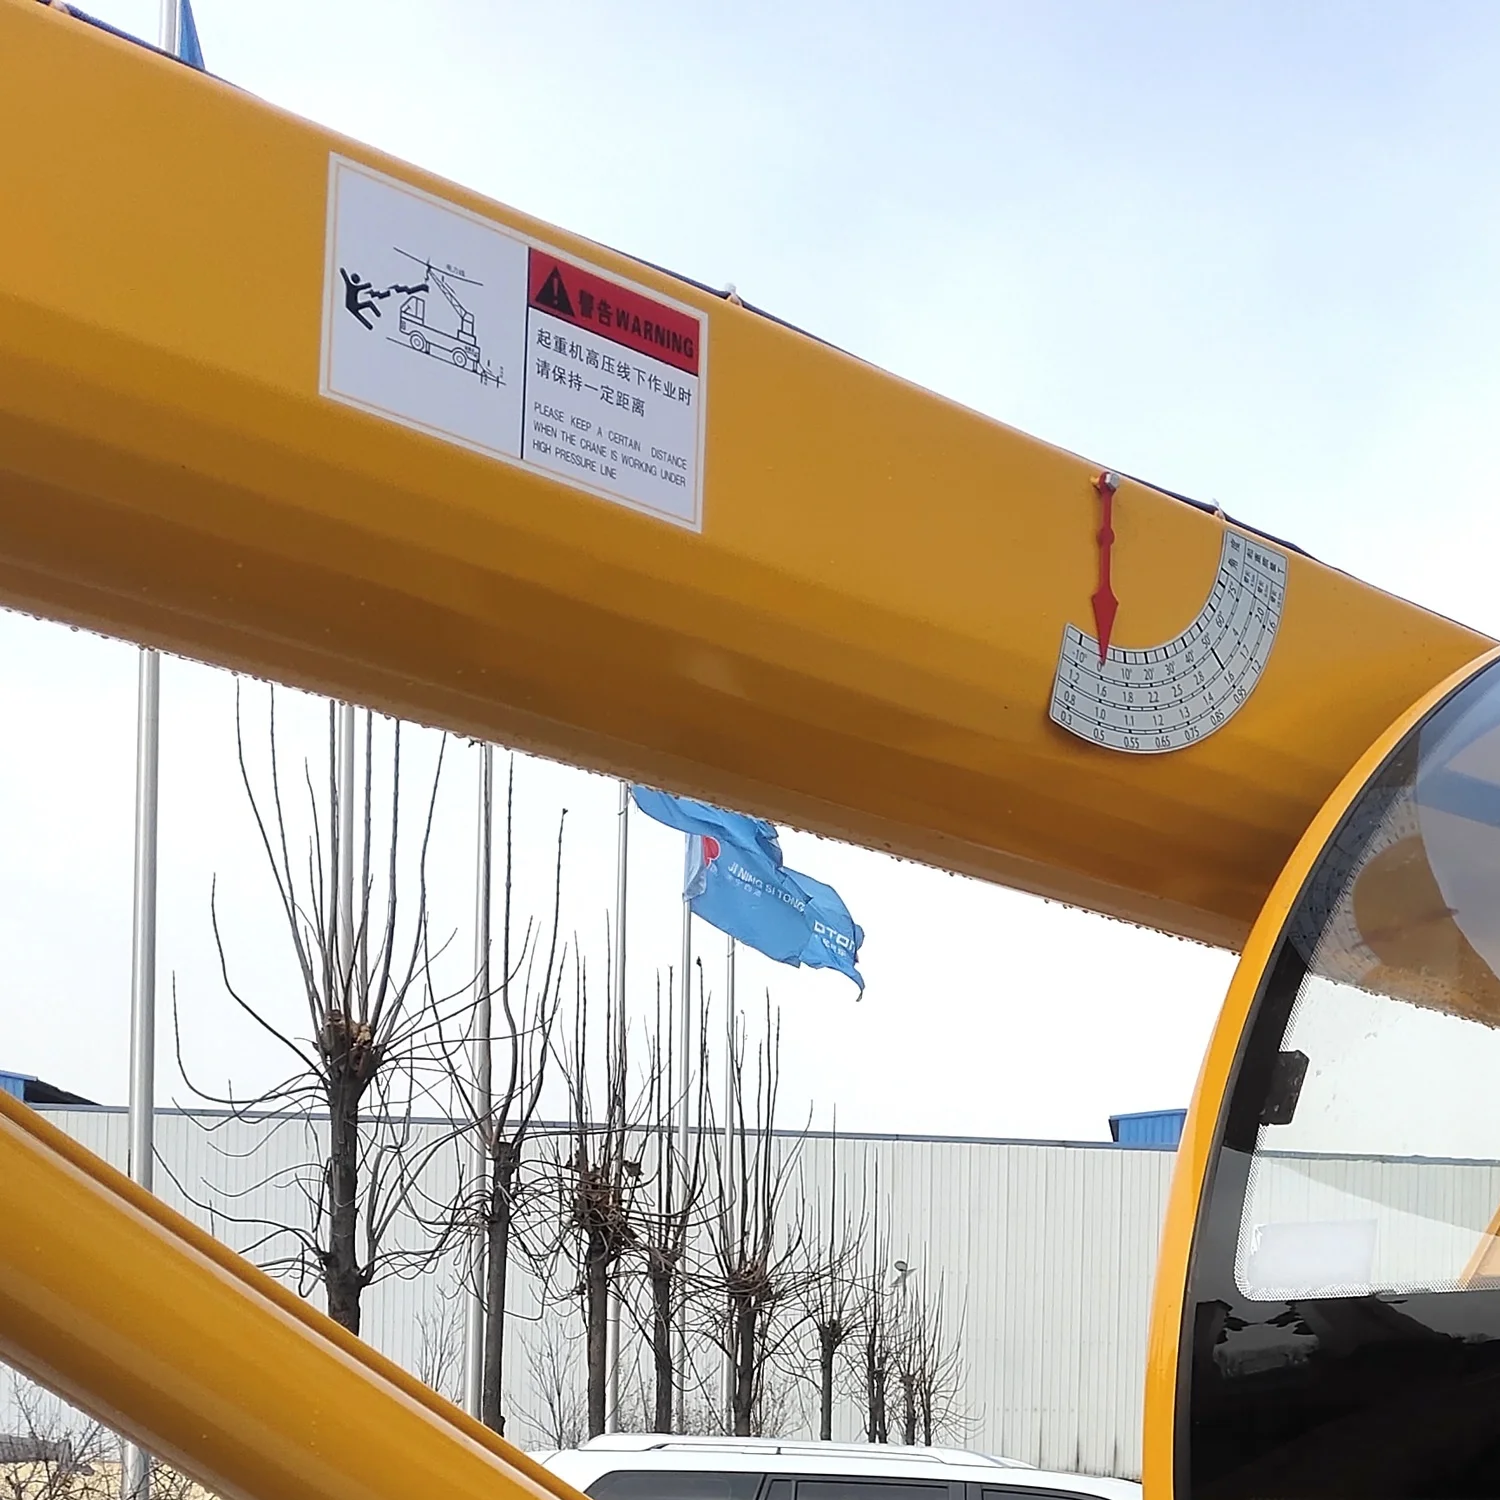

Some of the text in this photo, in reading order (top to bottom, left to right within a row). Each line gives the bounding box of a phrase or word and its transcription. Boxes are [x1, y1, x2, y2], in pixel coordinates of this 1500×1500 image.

[579, 289, 614, 328] 警告
[616, 307, 694, 359] WARNING
[535, 358, 646, 418] 请保持一定距离
[536, 327, 692, 406] 起重机高压线下作业时
[532, 438, 617, 480] HIGH PRESSURE LINE
[533, 419, 686, 488] WHEN THE CRANE IS WORKING UNDER
[534, 401, 688, 471] PLEASE KEEP A CERTAIN DISTANCE
[1063, 691, 1076, 706] 0.8
[1095, 706, 1106, 720] 1.0
[1124, 715, 1134, 726] 1.1
[1153, 715, 1164, 727] 1.2
[1179, 706, 1190, 719] 1.3
[1203, 692, 1214, 706] 1.4
[1224, 670, 1235, 685] 1.6
[1240, 644, 1250, 660] 1.7
[1069, 627, 1239, 703] 1.2 1.6 1.8 2.2 2.5 2.8 4
[1060, 710, 1072, 725] 0.3
[1093, 728, 1105, 741] 0.5
[1123, 736, 1140, 748] 0.55
[1155, 735, 1171, 748] 0.65
[1184, 726, 1200, 741] 0.75
[1210, 708, 1225, 726] 0.85
[1233, 685, 1247, 704] 0.95
